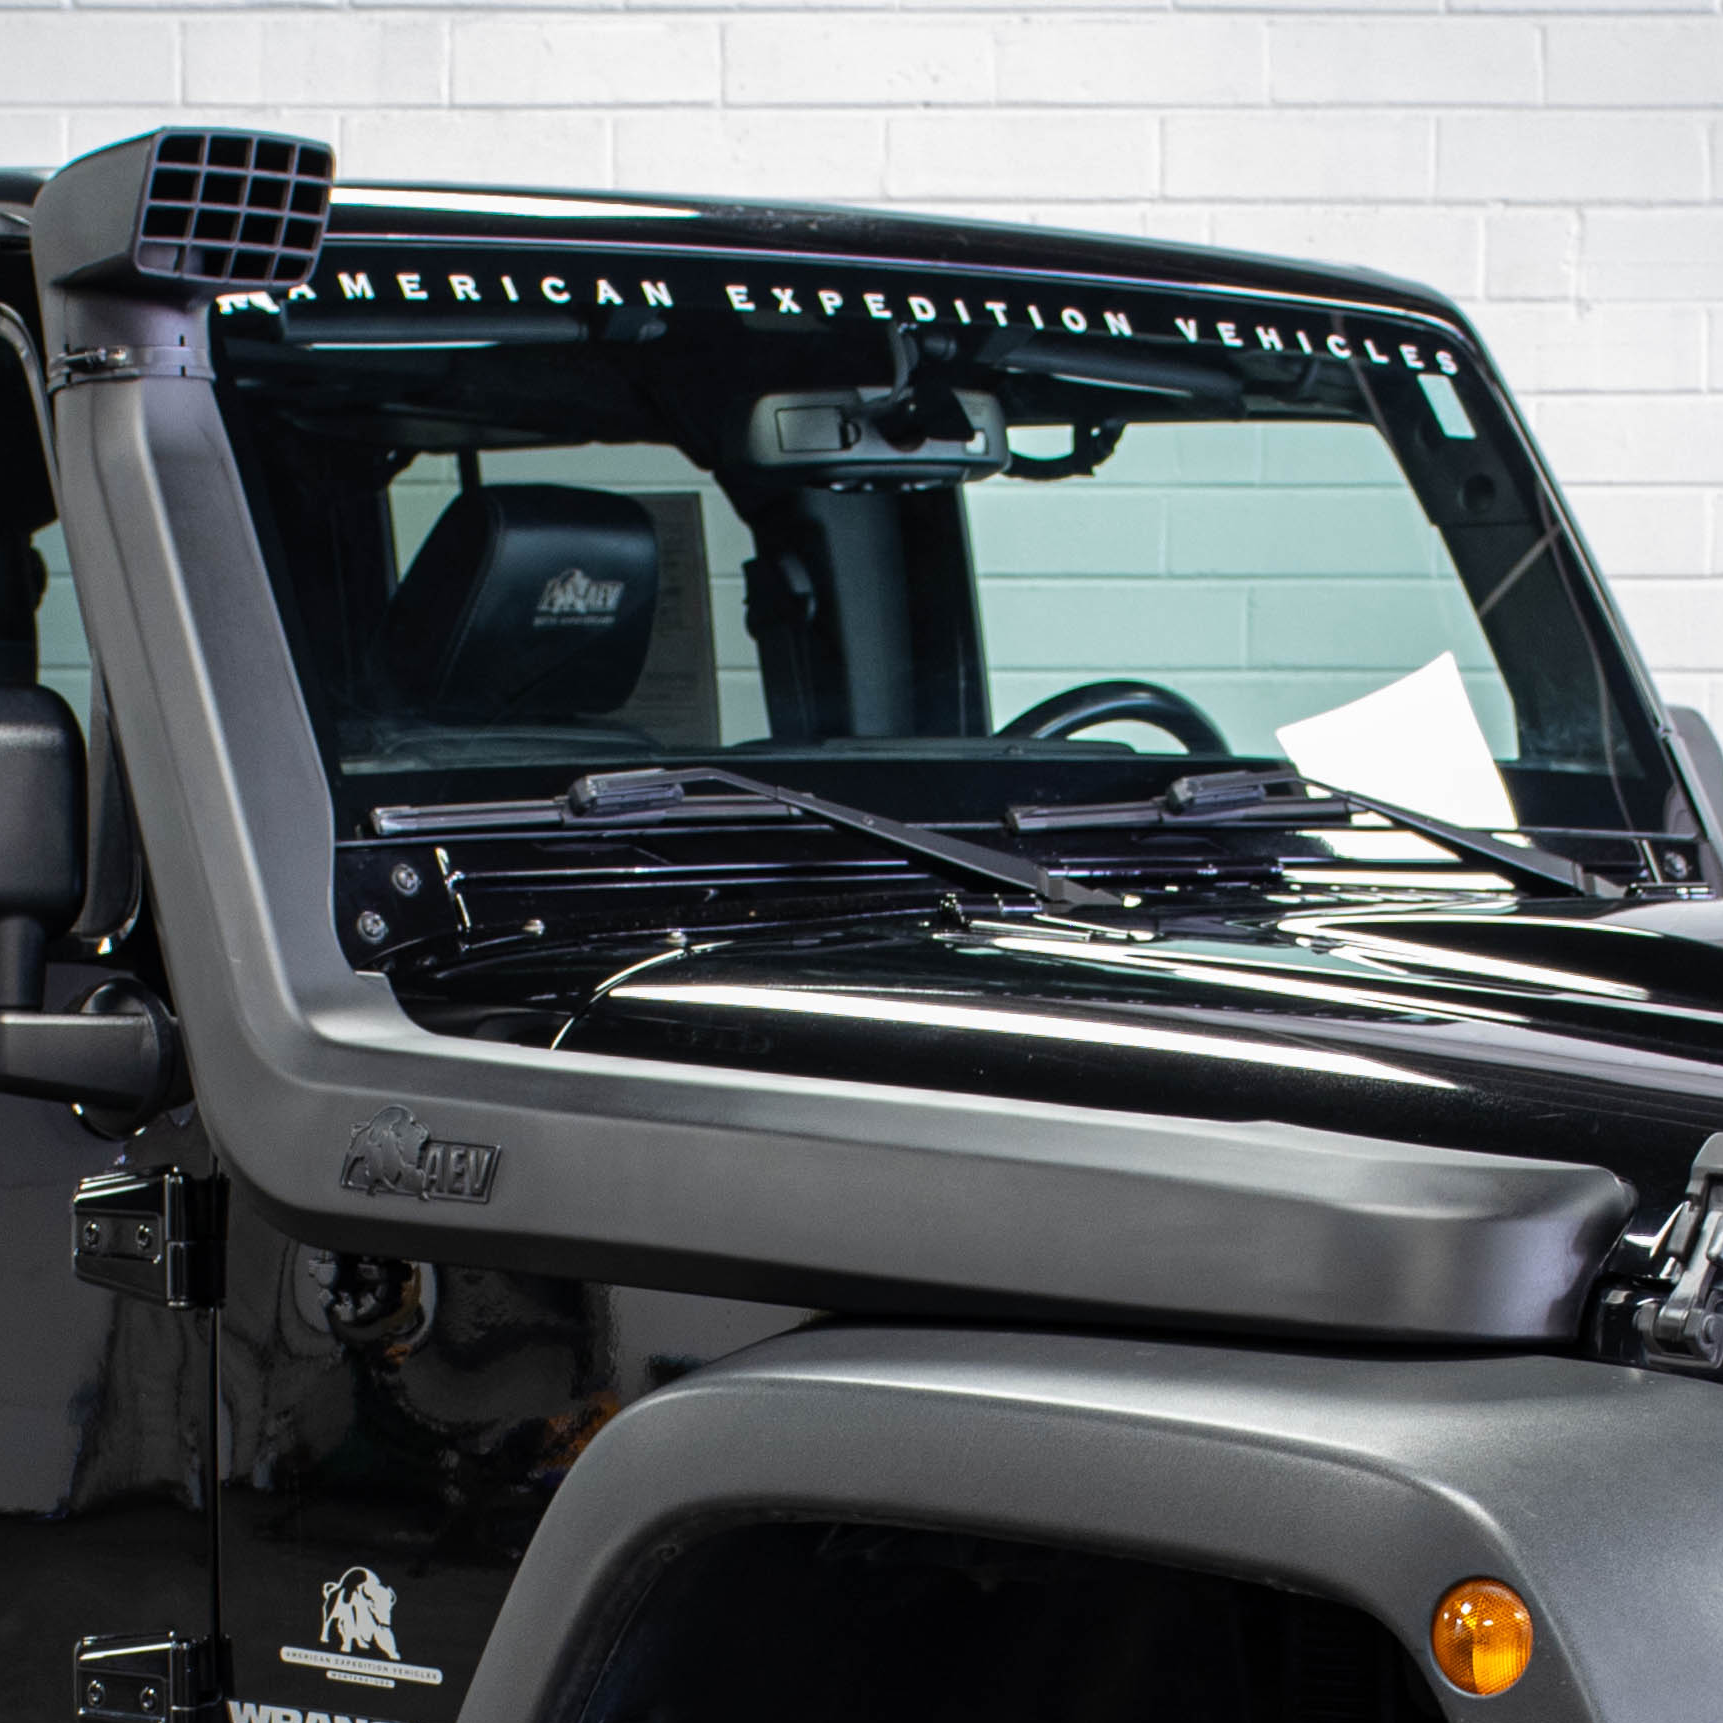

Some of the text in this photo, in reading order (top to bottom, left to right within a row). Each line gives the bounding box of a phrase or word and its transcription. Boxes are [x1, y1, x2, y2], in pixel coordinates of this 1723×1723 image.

[725, 284, 1133, 337] EXPEDITION
[1173, 317, 1459, 376] VEHICLES
[426, 1146, 492, 1197] AEV
